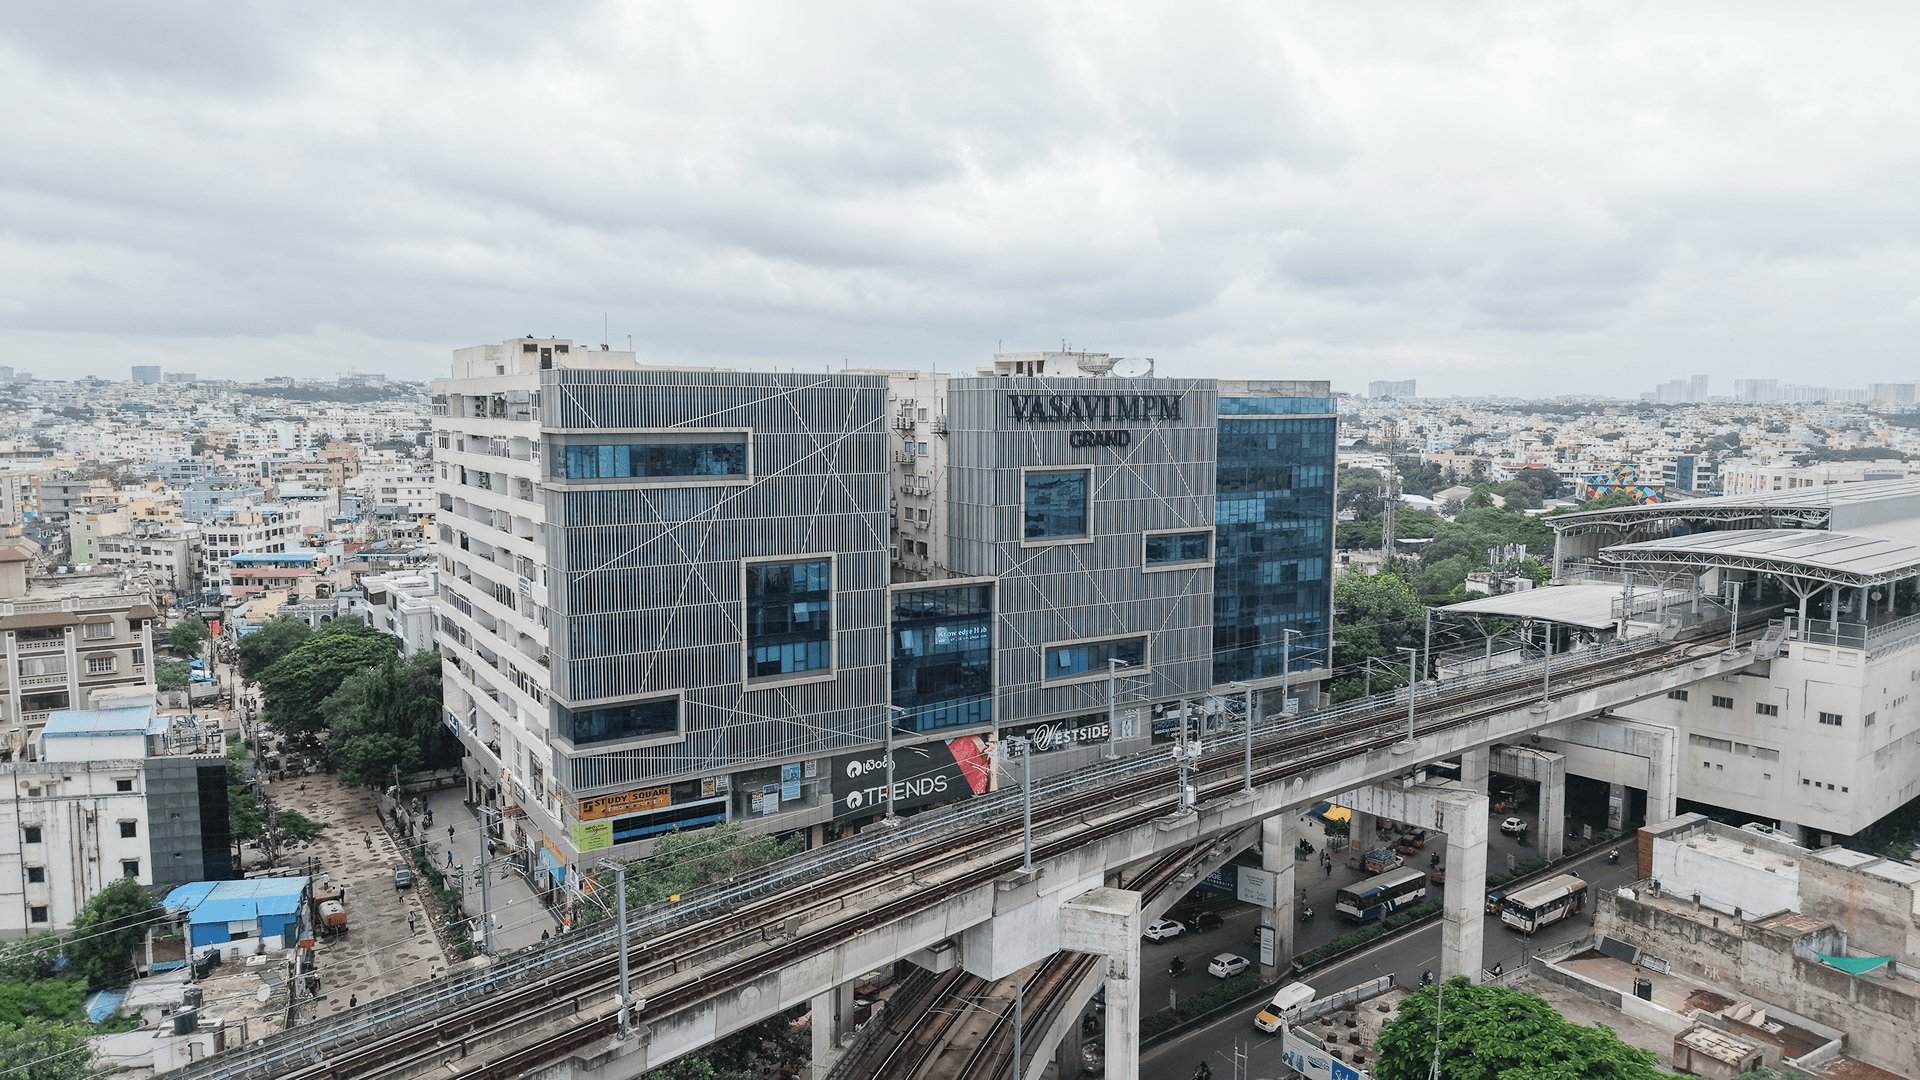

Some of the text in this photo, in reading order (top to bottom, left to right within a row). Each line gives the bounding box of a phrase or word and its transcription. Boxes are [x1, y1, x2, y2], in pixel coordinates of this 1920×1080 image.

[1069, 430, 1131, 448] GRAND
[1034, 722, 1109, 751] WESTSIDE
[594, 795, 628, 807] STUDY
[632, 787, 670, 800] SQUARE
[864, 775, 948, 806] TRENDS
